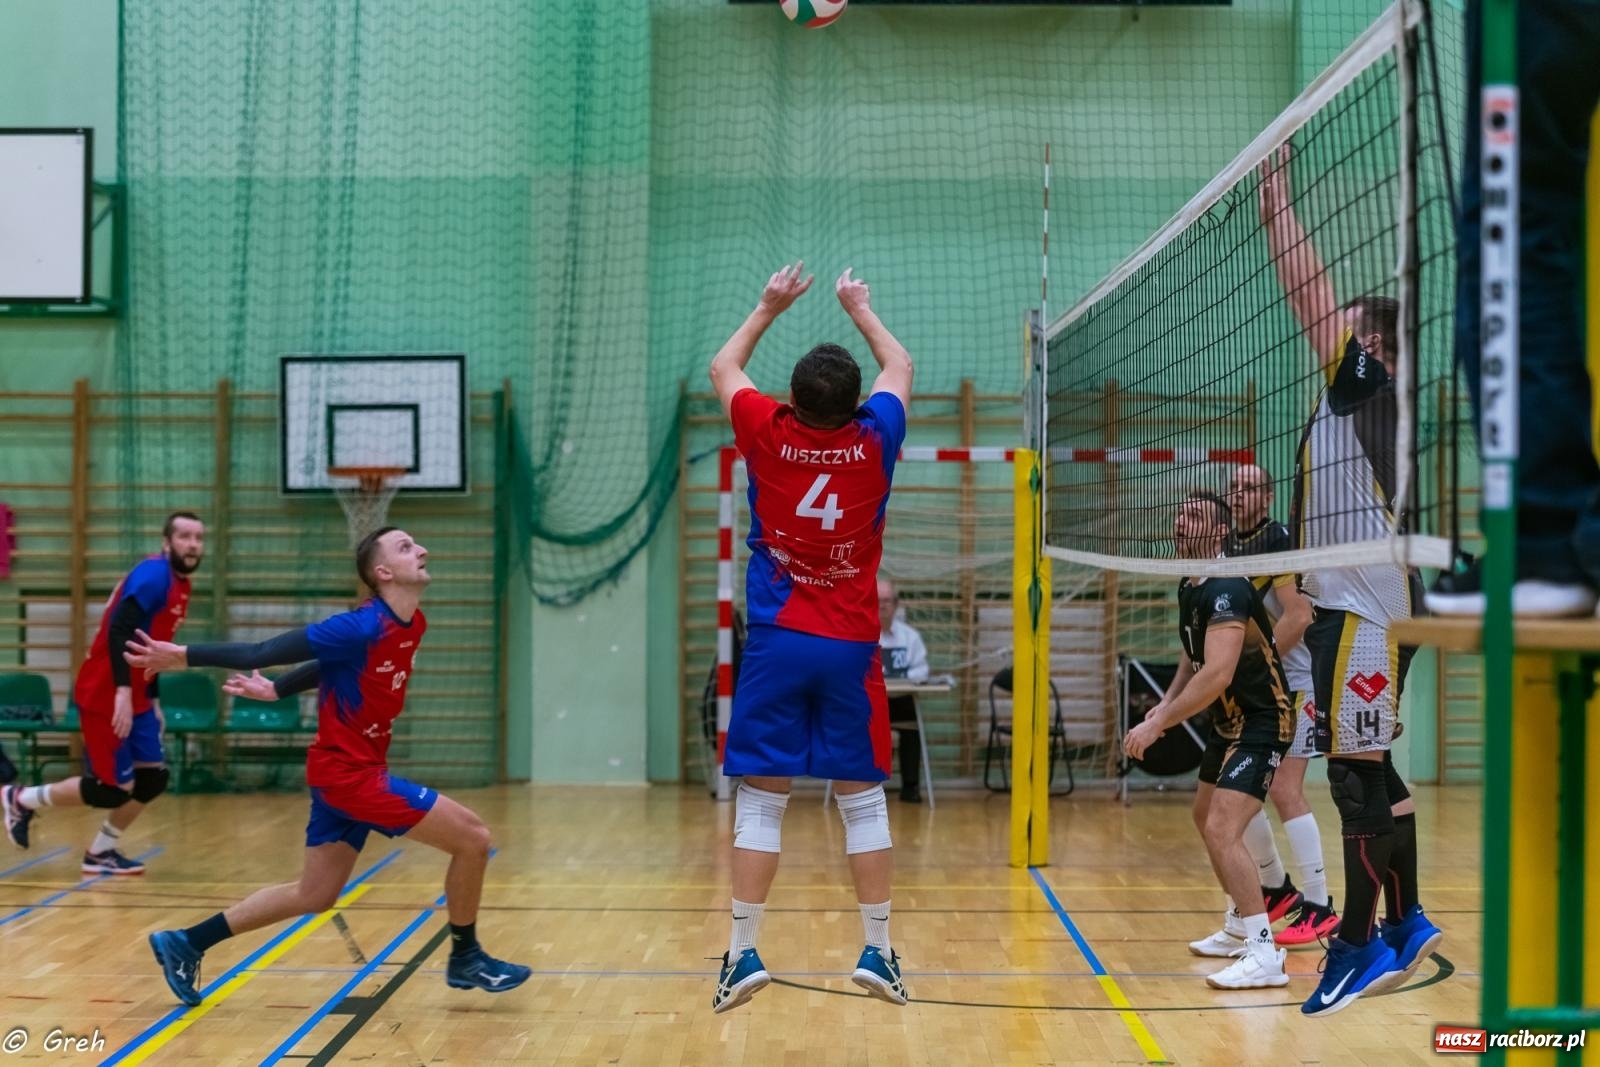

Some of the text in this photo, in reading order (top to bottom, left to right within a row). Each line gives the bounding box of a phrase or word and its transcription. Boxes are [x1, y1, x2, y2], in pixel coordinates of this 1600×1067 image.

[796, 473, 844, 531] 4
[1355, 676, 1376, 694] Enter
[1356, 709, 1380, 738] 14
